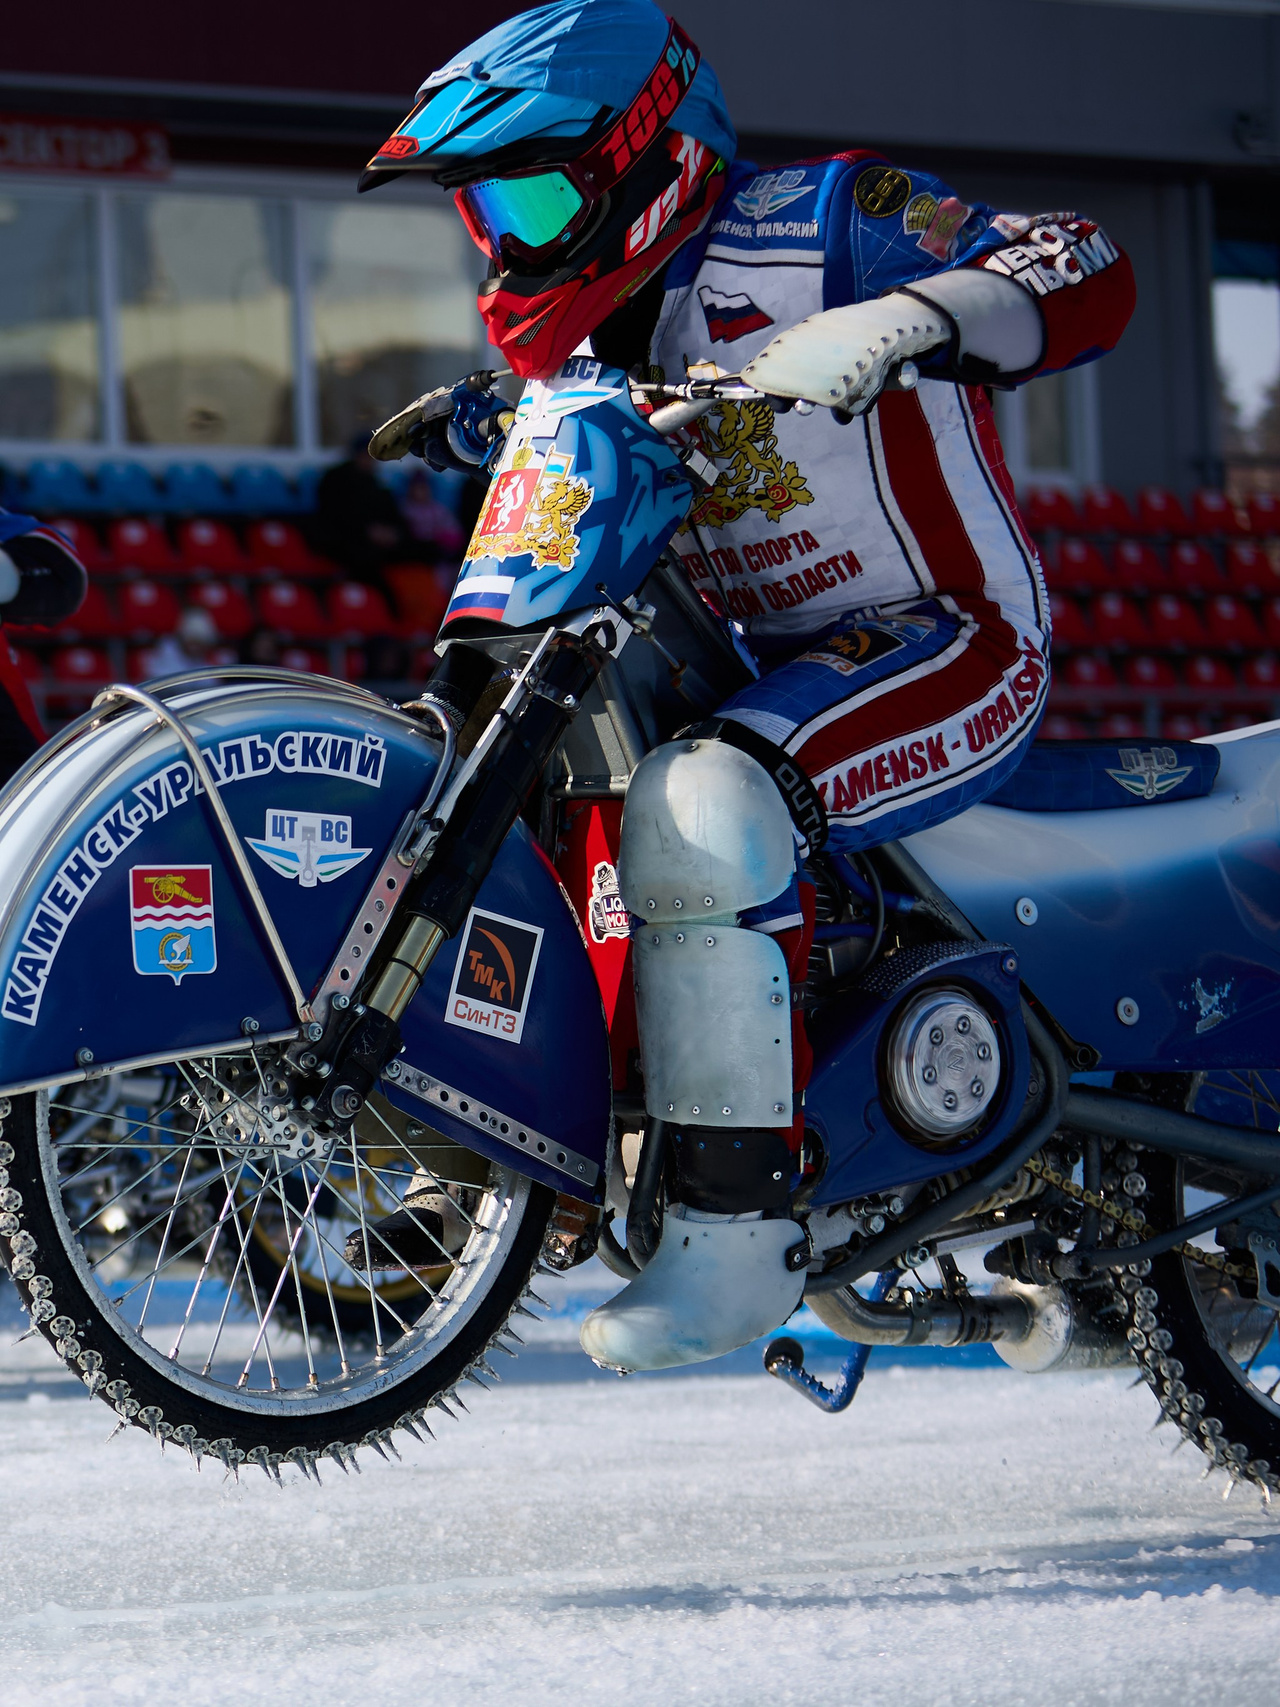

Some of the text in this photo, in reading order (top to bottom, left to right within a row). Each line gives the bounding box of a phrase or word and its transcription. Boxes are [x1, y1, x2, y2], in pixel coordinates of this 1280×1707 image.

[600, 34, 697, 176] 100%
[742, 530, 820, 574] СПОРТА
[760, 549, 863, 612] ОБЛАСТИ
[271, 815, 348, 843] ЦТ ВС
[603, 896, 627, 913] LIQ
[606, 911, 630, 929] MOL
[468, 949, 507, 1002] ТМК
